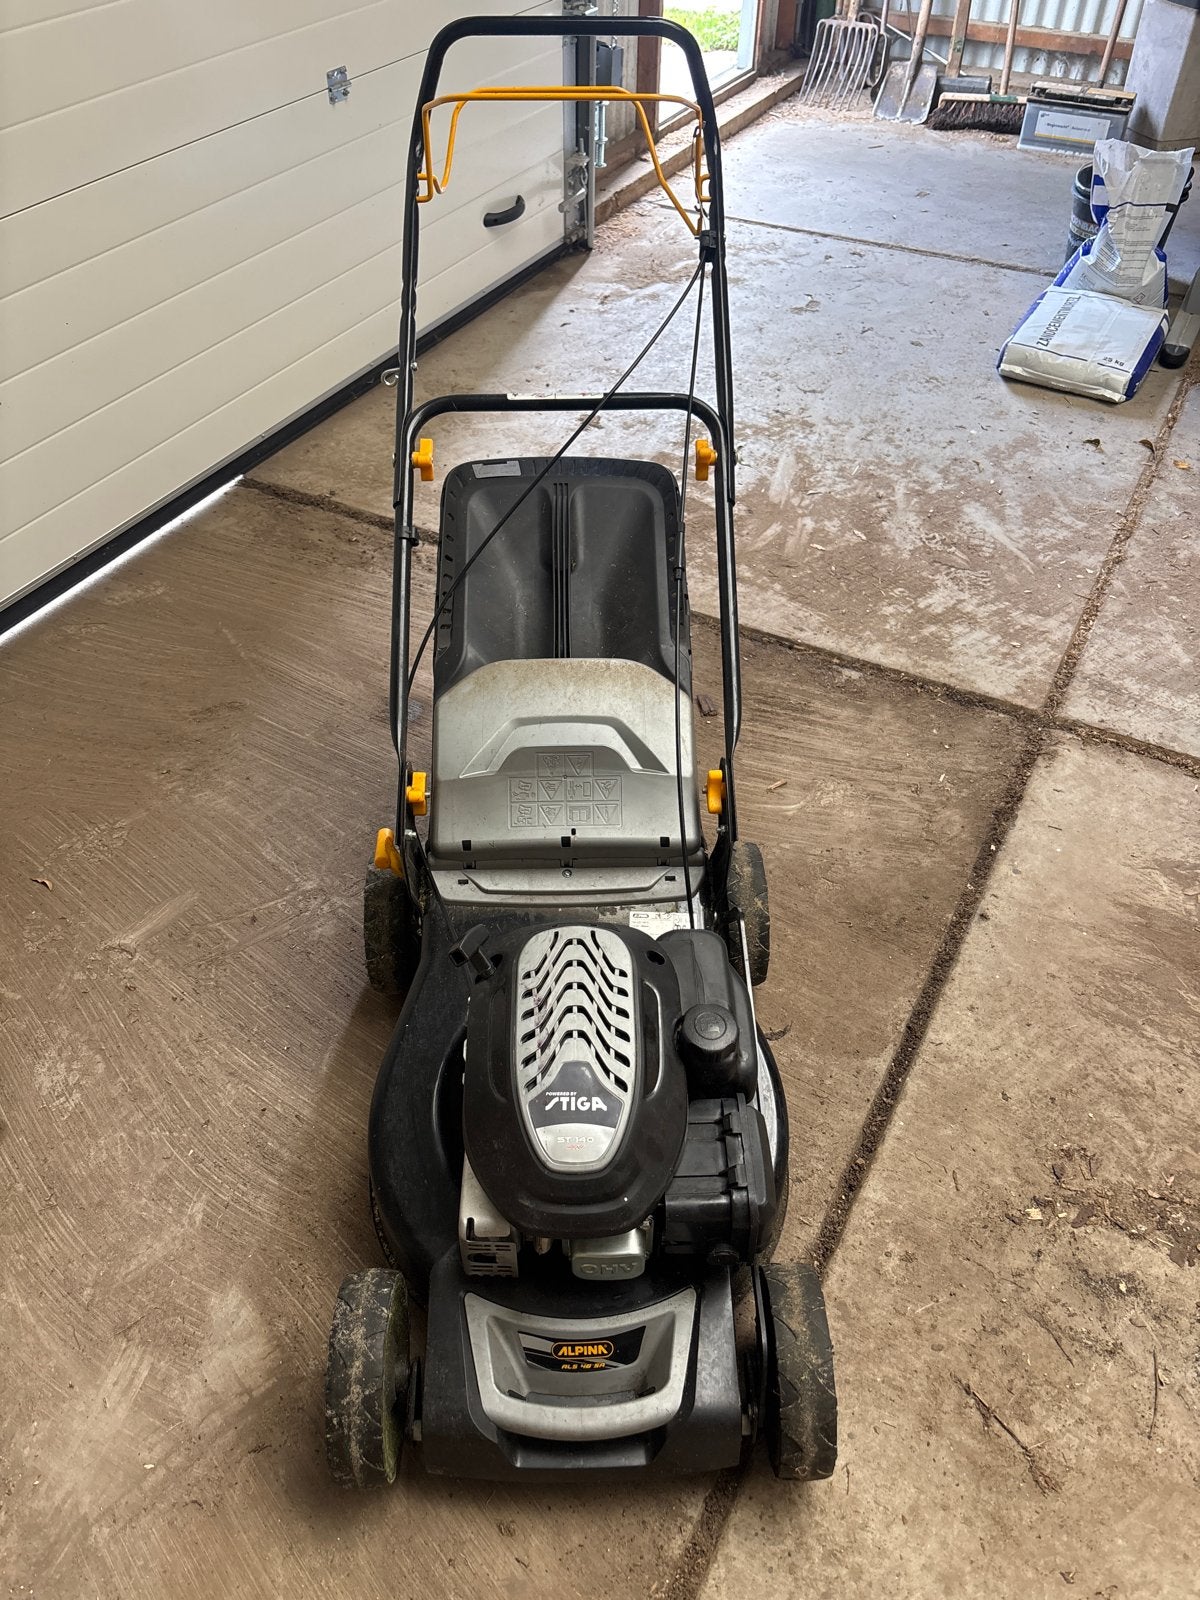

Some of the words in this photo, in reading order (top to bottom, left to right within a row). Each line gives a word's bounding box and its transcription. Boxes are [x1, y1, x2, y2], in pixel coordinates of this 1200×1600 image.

[545, 1096, 608, 1112] STIGA
[580, 1263, 638, 1274] OHV
[558, 1344, 608, 1356] ALPINA
